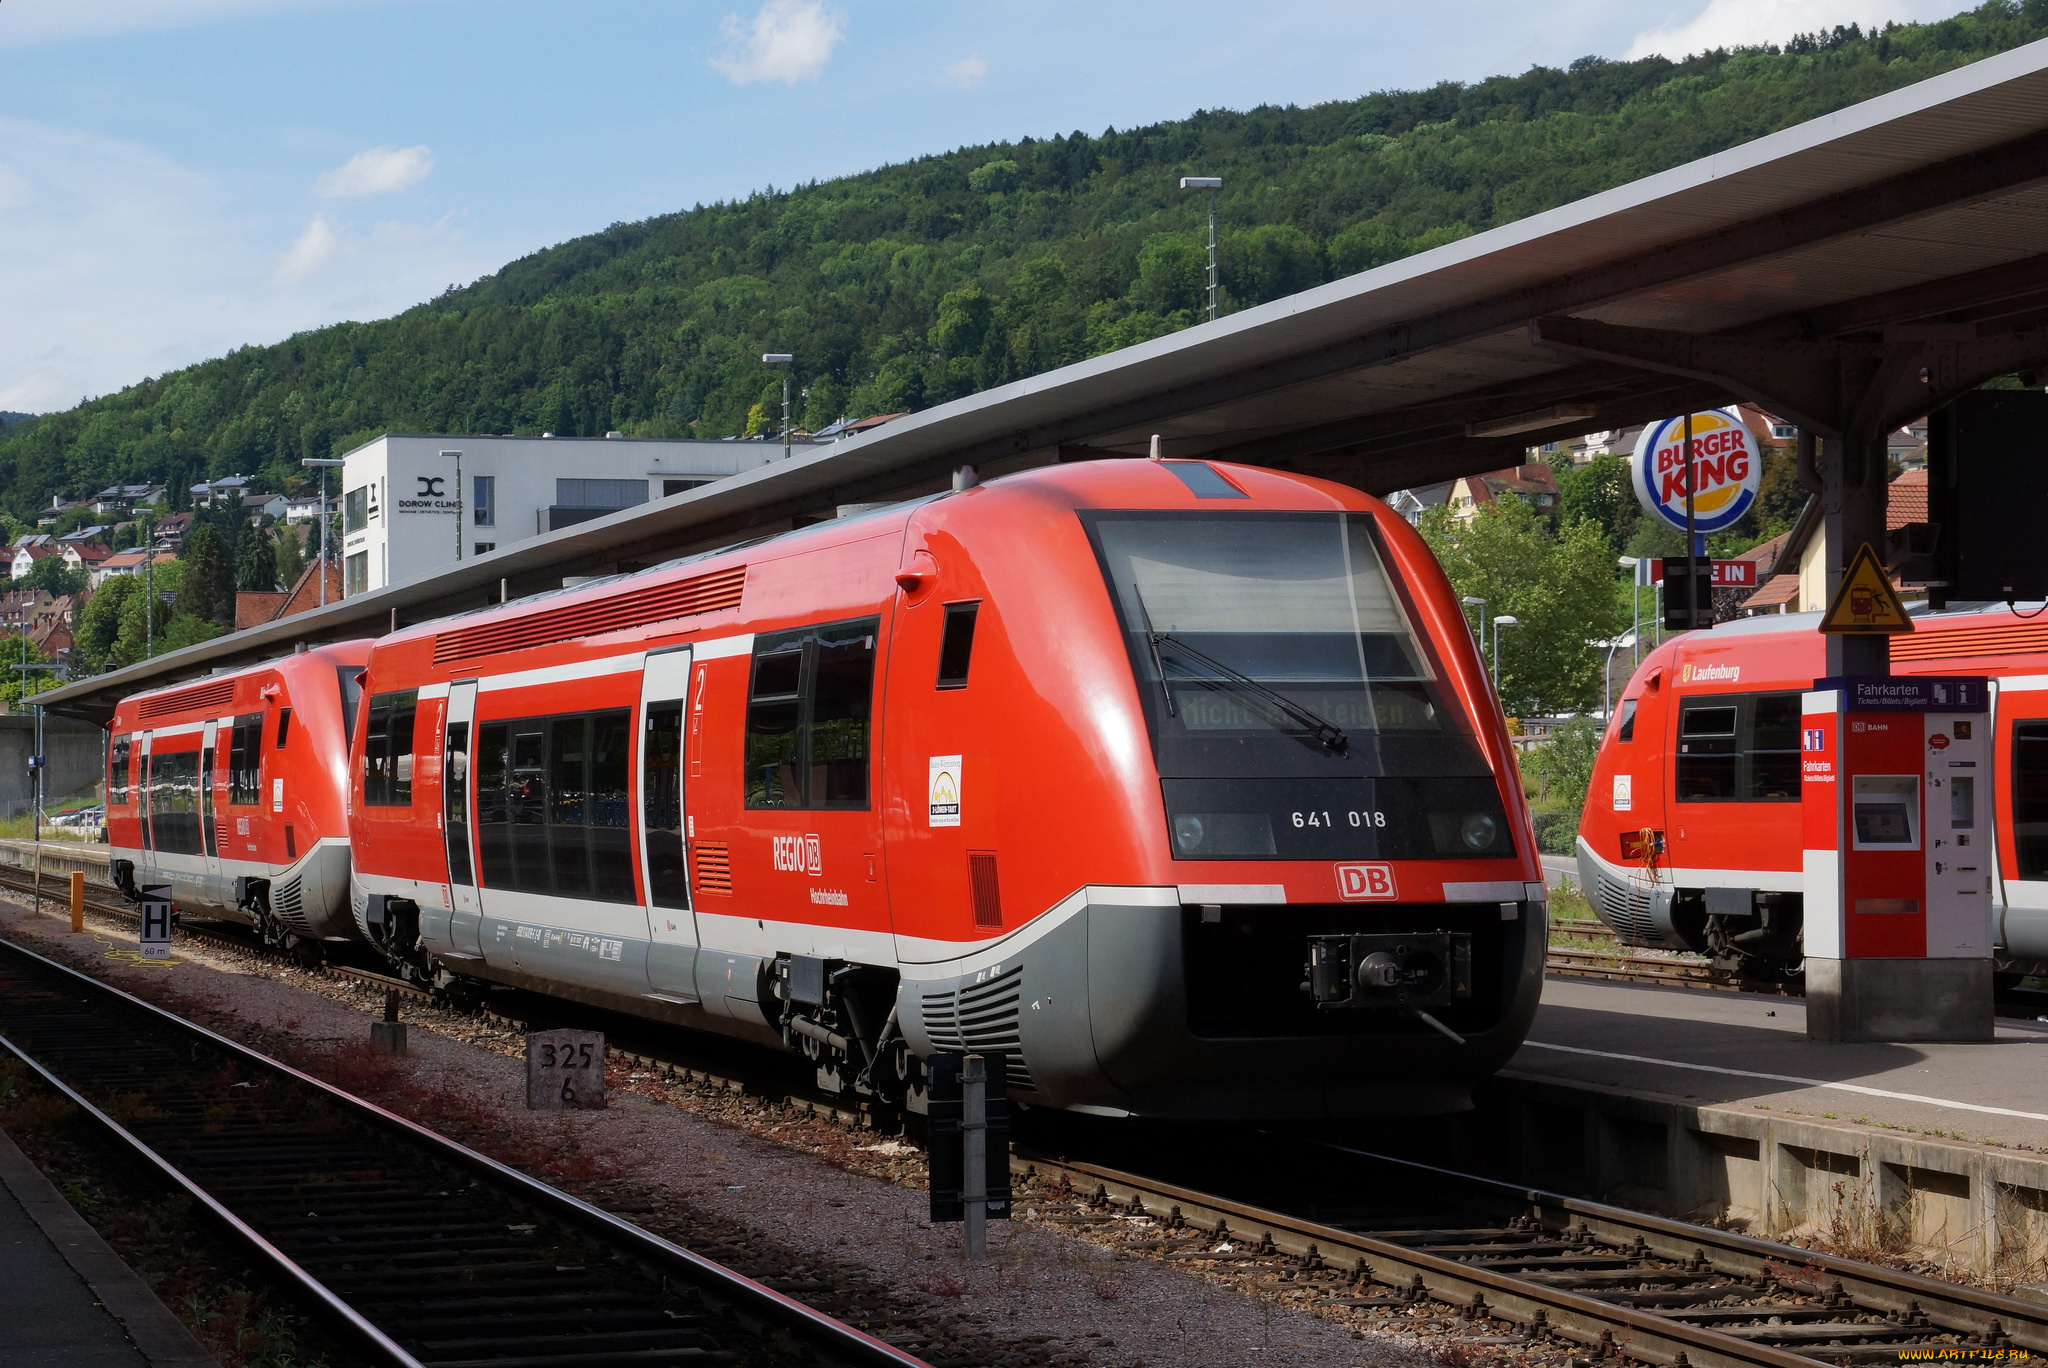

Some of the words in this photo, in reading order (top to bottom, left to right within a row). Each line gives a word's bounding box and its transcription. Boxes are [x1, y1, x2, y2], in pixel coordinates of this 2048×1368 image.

[1658, 429, 1745, 474] BURGER
[1661, 450, 1749, 505] KING
[399, 500, 432, 508] DOROW
[434, 500, 463, 508] CLIN
[1725, 565, 1744, 581] IN
[1692, 663, 1741, 683] Laufenburg
[694, 668, 705, 711] 2
[1857, 683, 1919, 696] Fahrkarten
[1803, 760, 1831, 772] Fahrkarten
[1292, 811, 1332, 828] 641
[1348, 811, 1386, 828] 018
[773, 836, 806, 872] REGIO
[807, 841, 820, 868] DB
[1343, 868, 1390, 894] DB
[145, 905, 167, 938] H
[144, 947, 155, 956] 60
[157, 948, 166, 956] m
[541, 1043, 594, 1070] 325
[560, 1077, 576, 1102] 6
